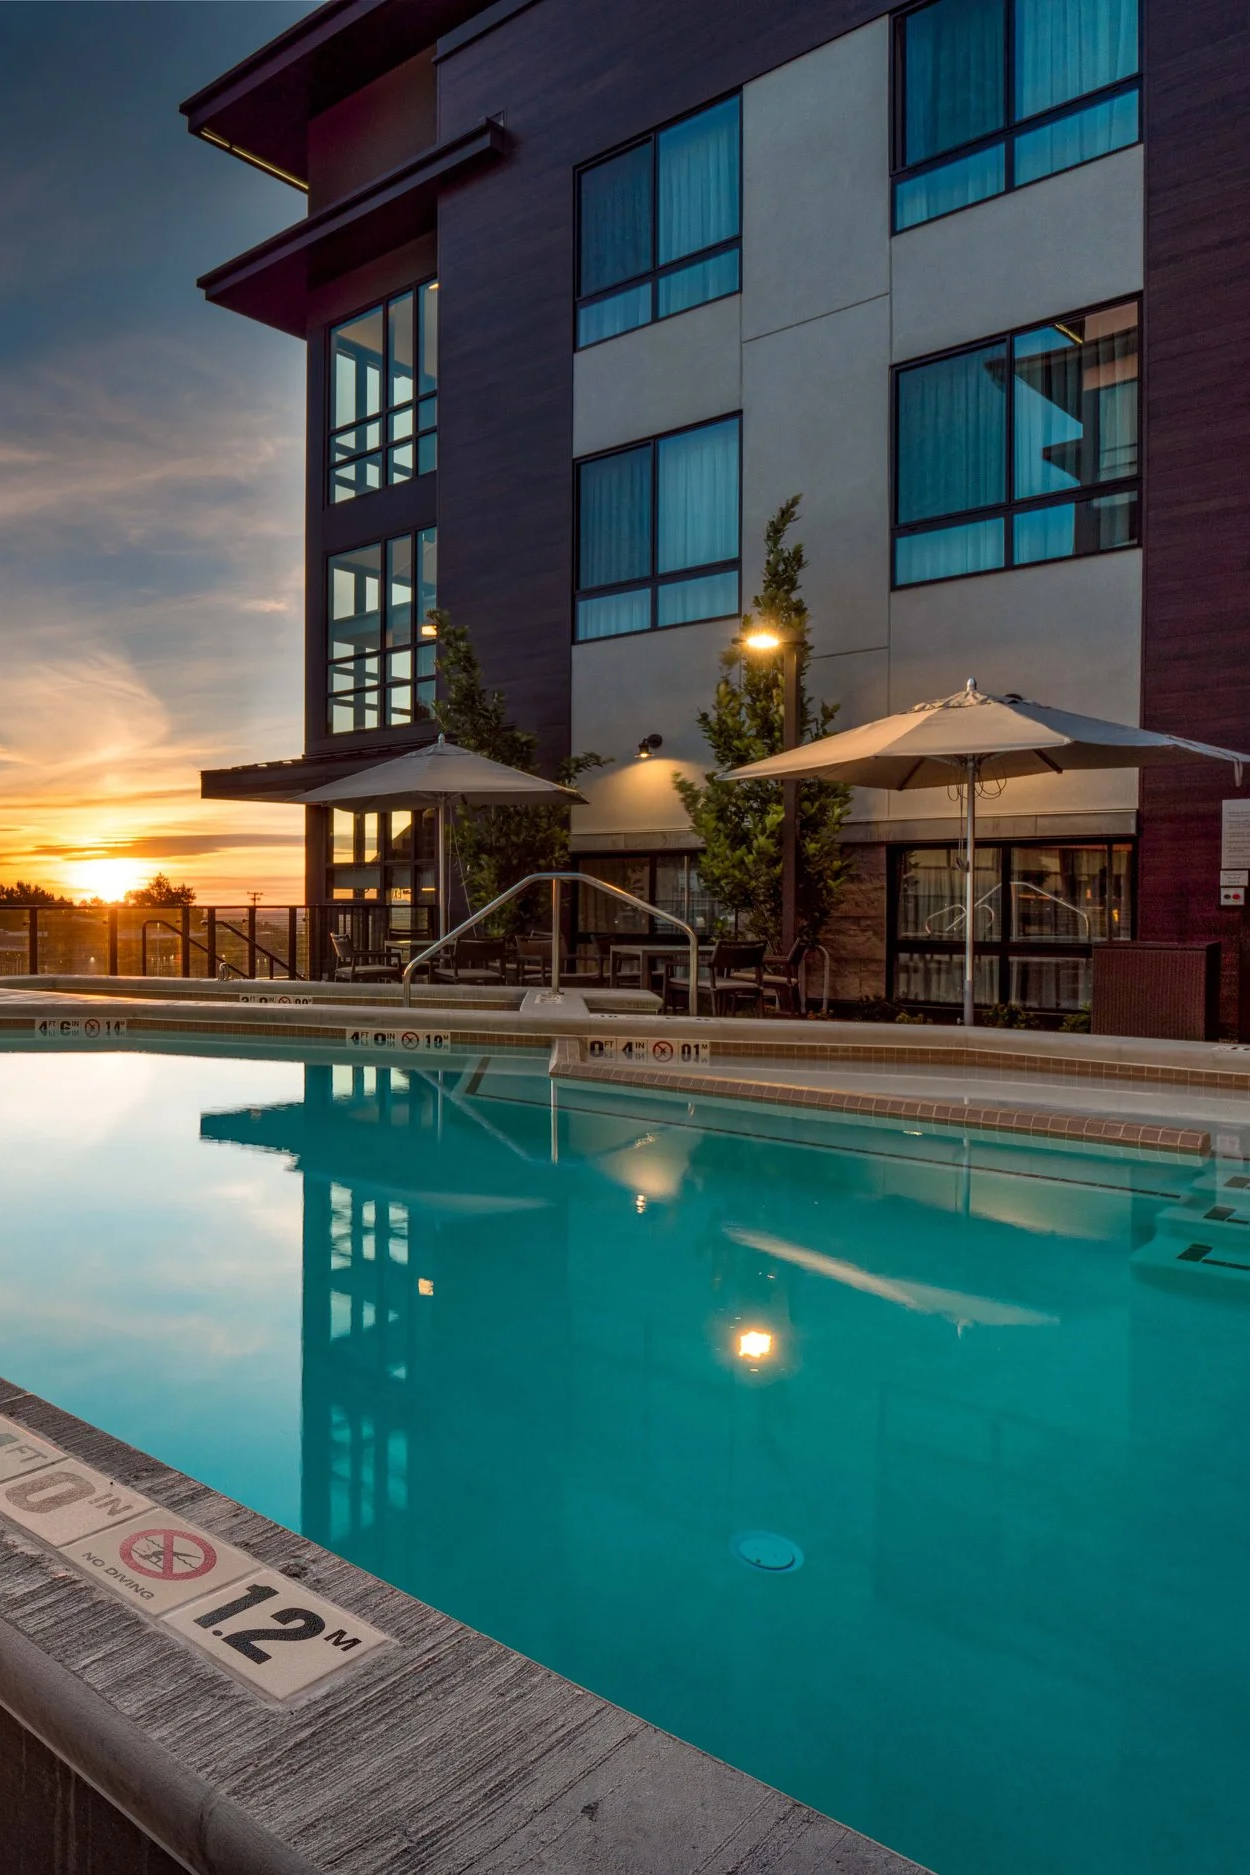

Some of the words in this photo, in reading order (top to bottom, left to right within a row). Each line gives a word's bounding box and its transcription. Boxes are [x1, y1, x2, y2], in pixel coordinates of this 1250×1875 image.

[387, 1032, 395, 1040] IN
[635, 1041, 645, 1049] IN
[5, 1445, 48, 1464] FT
[5, 1471, 96, 1514] 0
[94, 1492, 134, 1517] IN
[81, 1551, 106, 1567] NO
[104, 1567, 155, 1600] DIVING
[193, 1583, 326, 1665] 1.2
[323, 1629, 363, 1652] M
